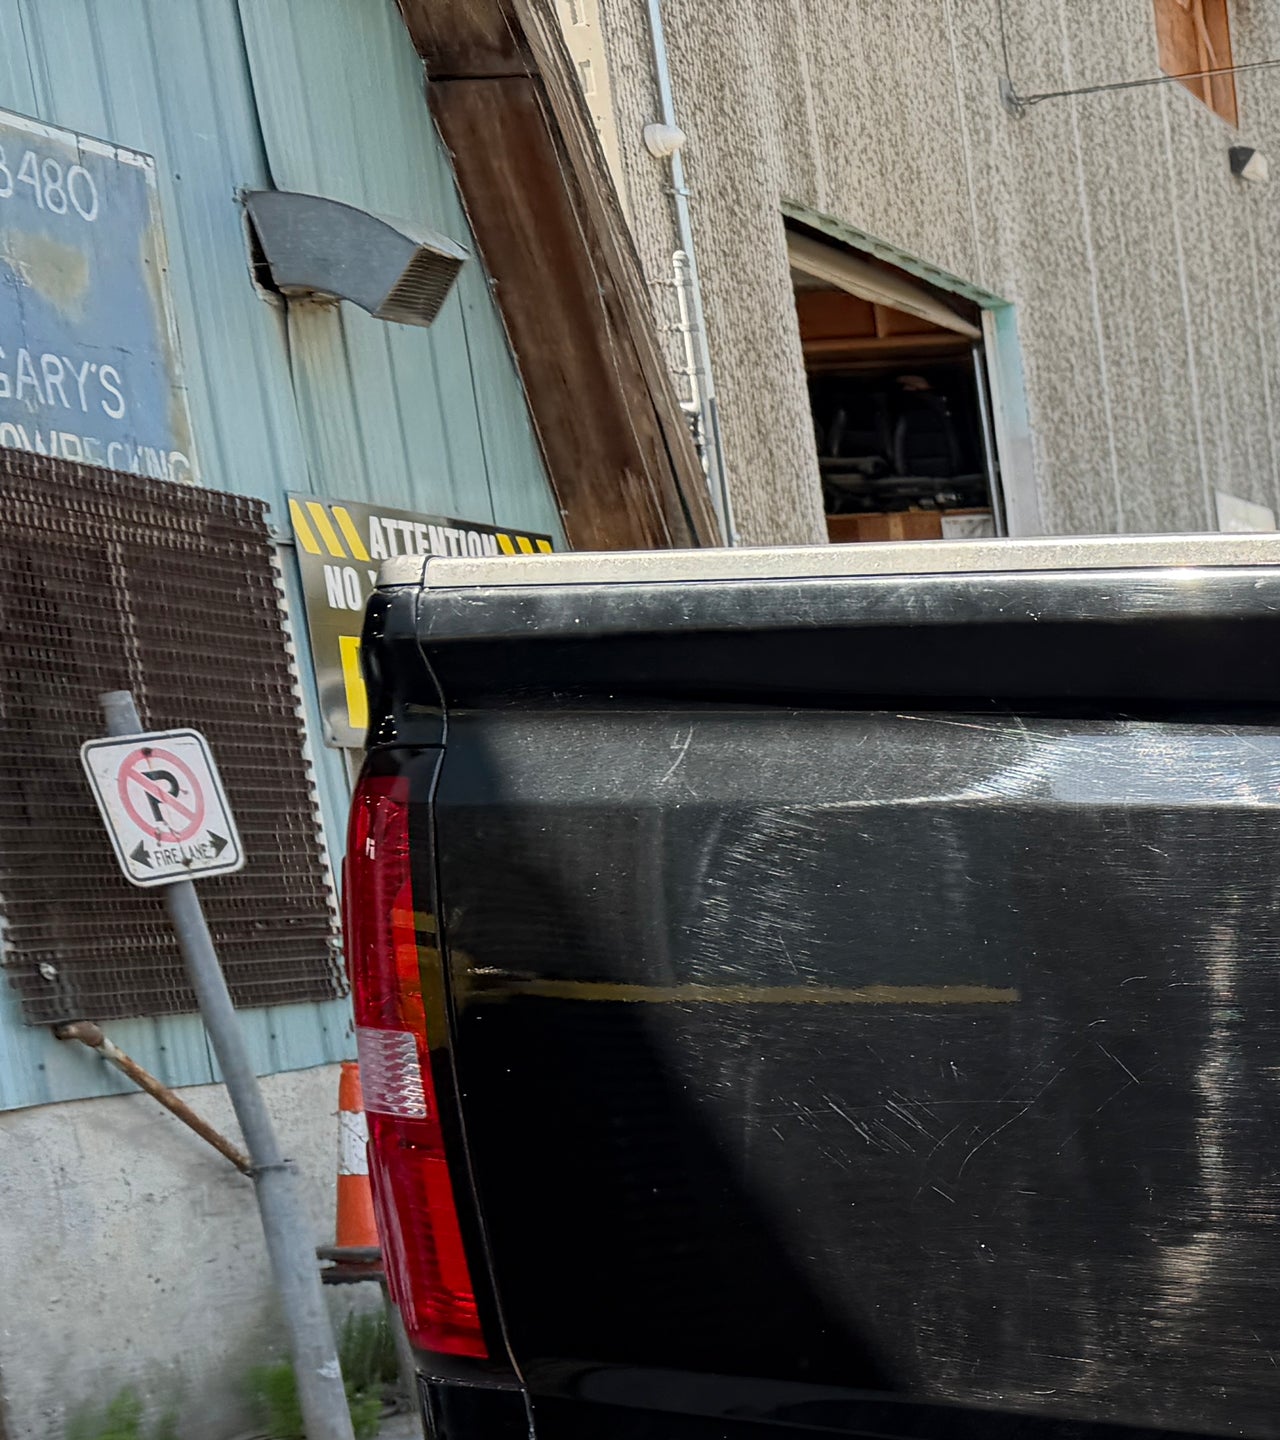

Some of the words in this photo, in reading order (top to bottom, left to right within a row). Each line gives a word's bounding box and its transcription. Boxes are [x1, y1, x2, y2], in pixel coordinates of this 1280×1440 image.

[368, 516, 498, 560] ATTENTION
[324, 565, 362, 611] NO
[153, 848, 181, 867] FIRE
[179, 843, 213, 863] LANE
